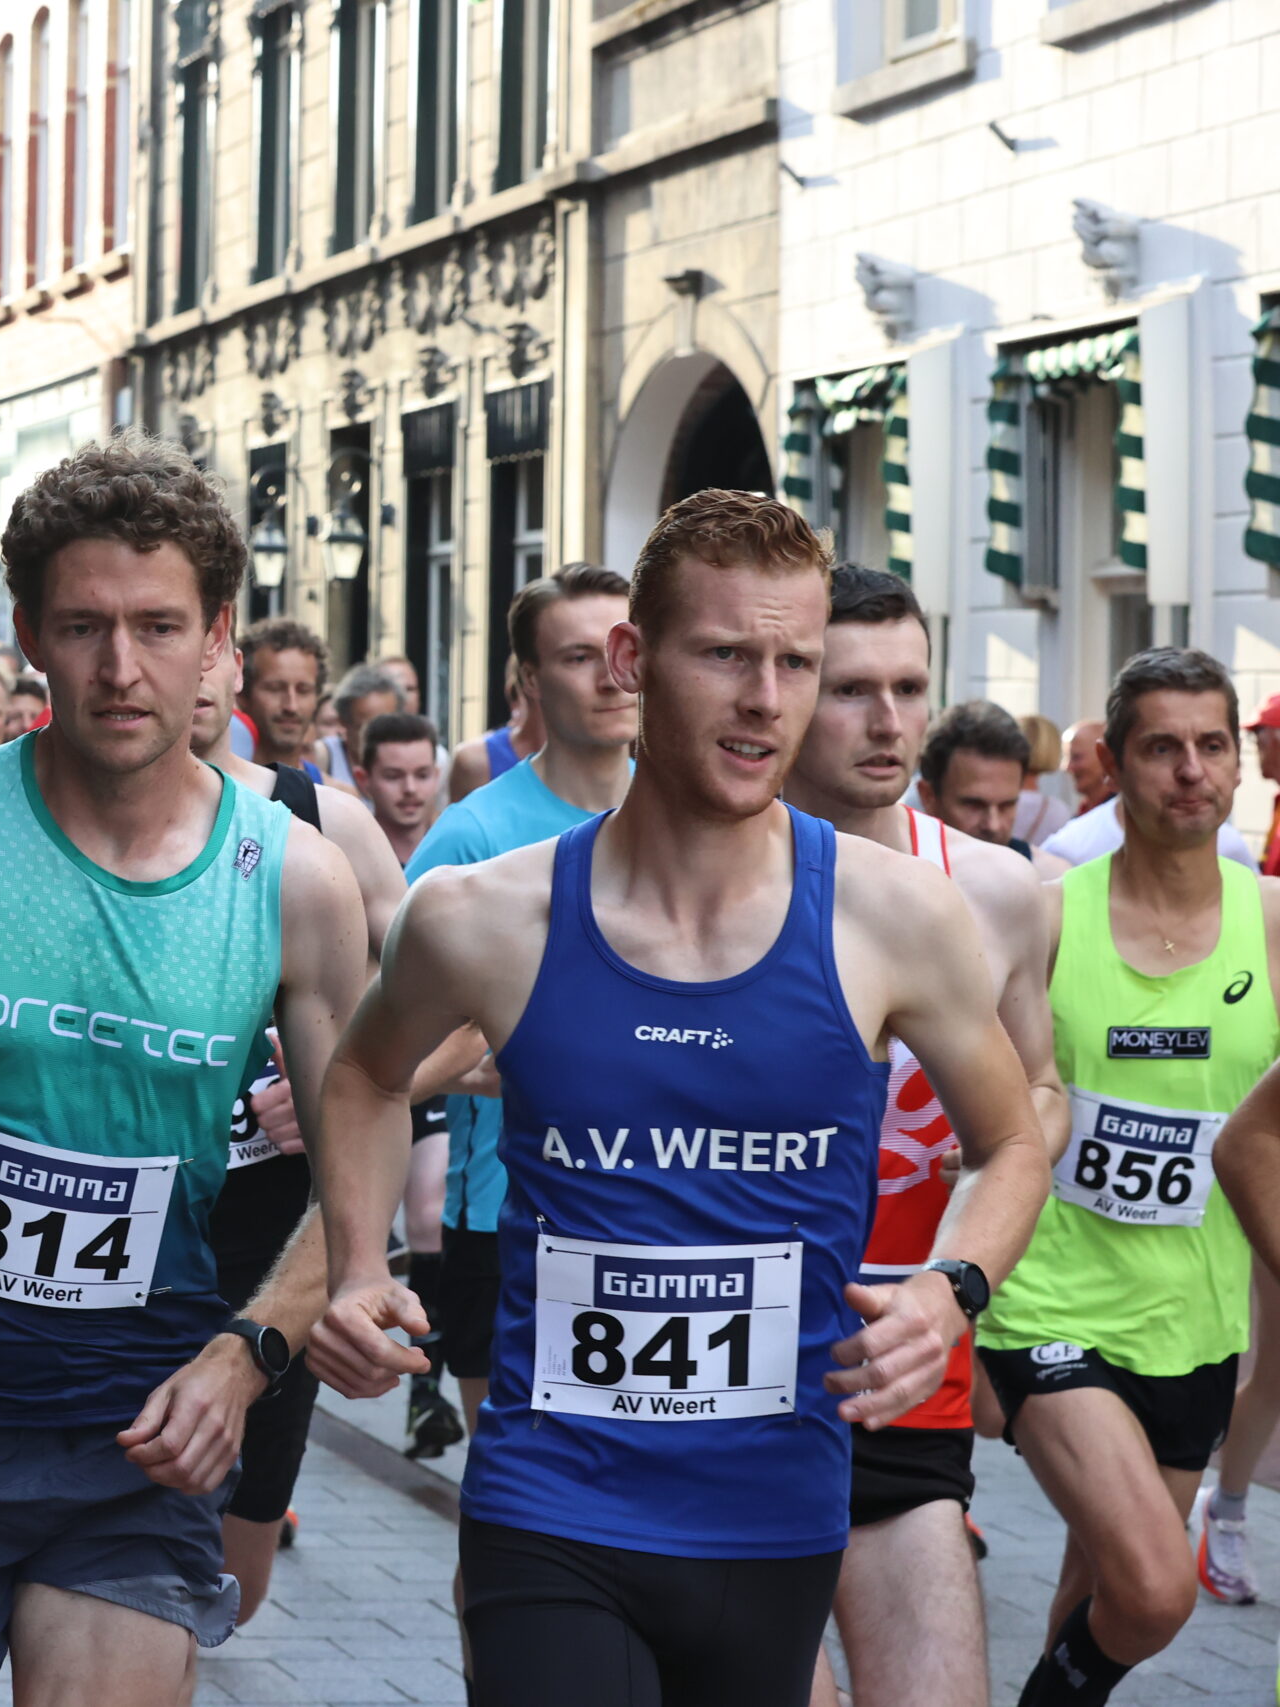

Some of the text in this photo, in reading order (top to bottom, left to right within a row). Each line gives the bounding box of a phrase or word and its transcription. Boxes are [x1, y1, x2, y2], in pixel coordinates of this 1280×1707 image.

[635, 1025, 712, 1046] CRAFT
[542, 1126, 839, 1173] A.V. WEERT
[1075, 1139, 1195, 1205] 856
[1093, 1197, 1158, 1221] AV Weert
[22, 1280, 83, 1304] Weert
[571, 1310, 751, 1390] 841
[611, 1395, 717, 1415] AV Weert
